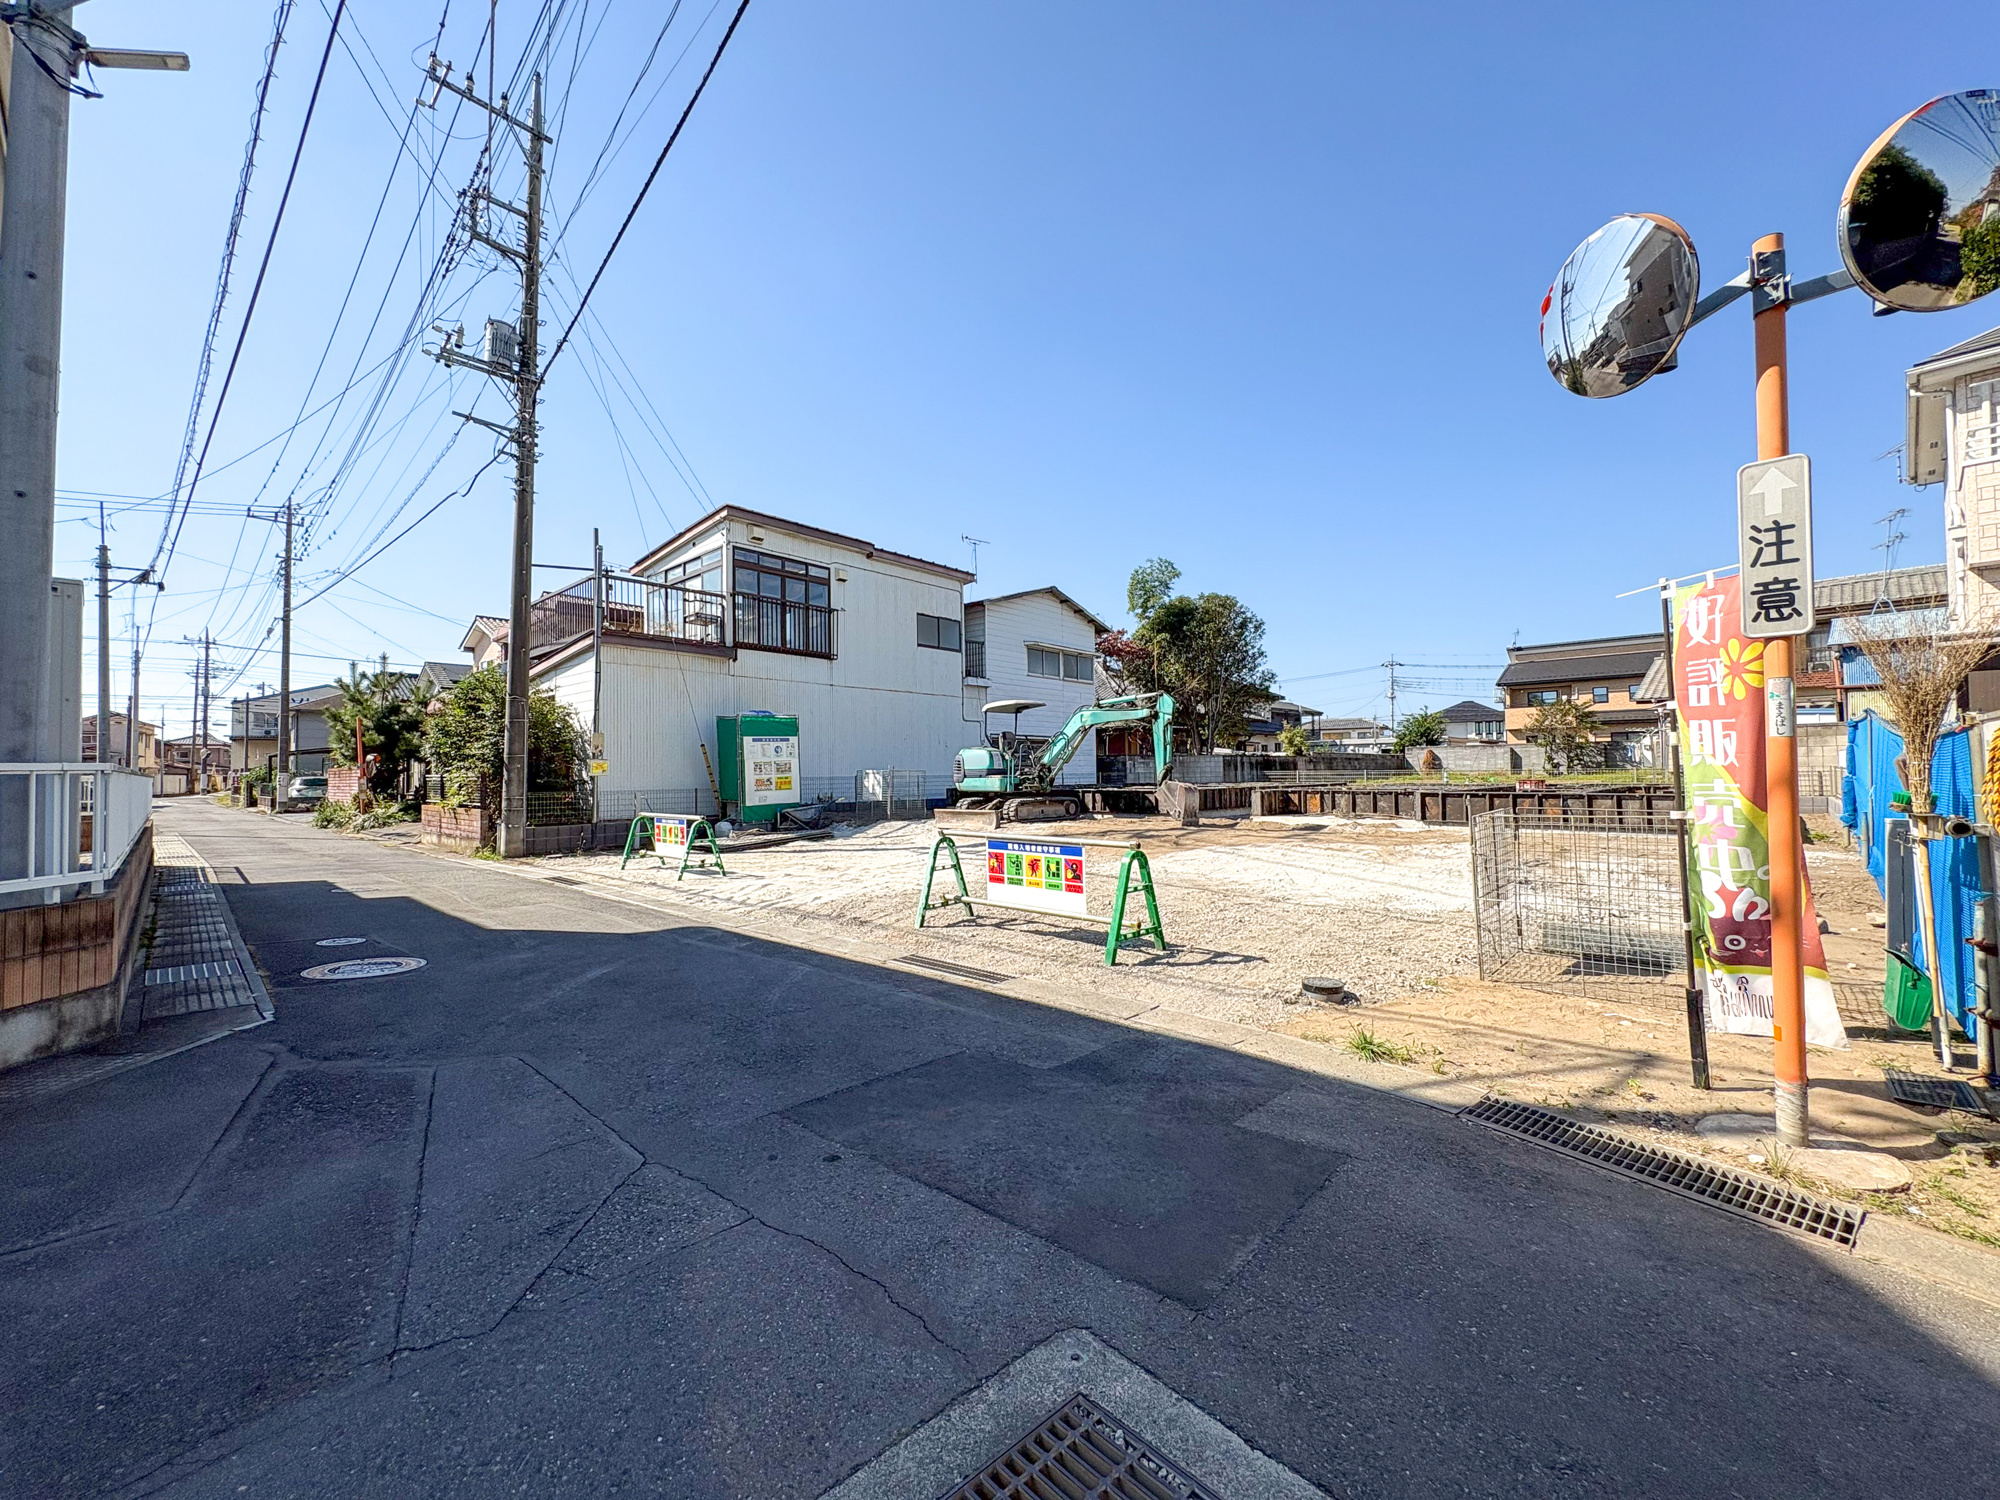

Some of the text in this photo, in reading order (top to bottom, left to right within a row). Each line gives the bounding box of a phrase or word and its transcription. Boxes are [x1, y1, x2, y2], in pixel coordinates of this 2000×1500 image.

[1748, 519, 1803, 623] 注意
[1685, 593, 1755, 892] 好評販売中
[1775, 700, 1787, 736] まえばし
